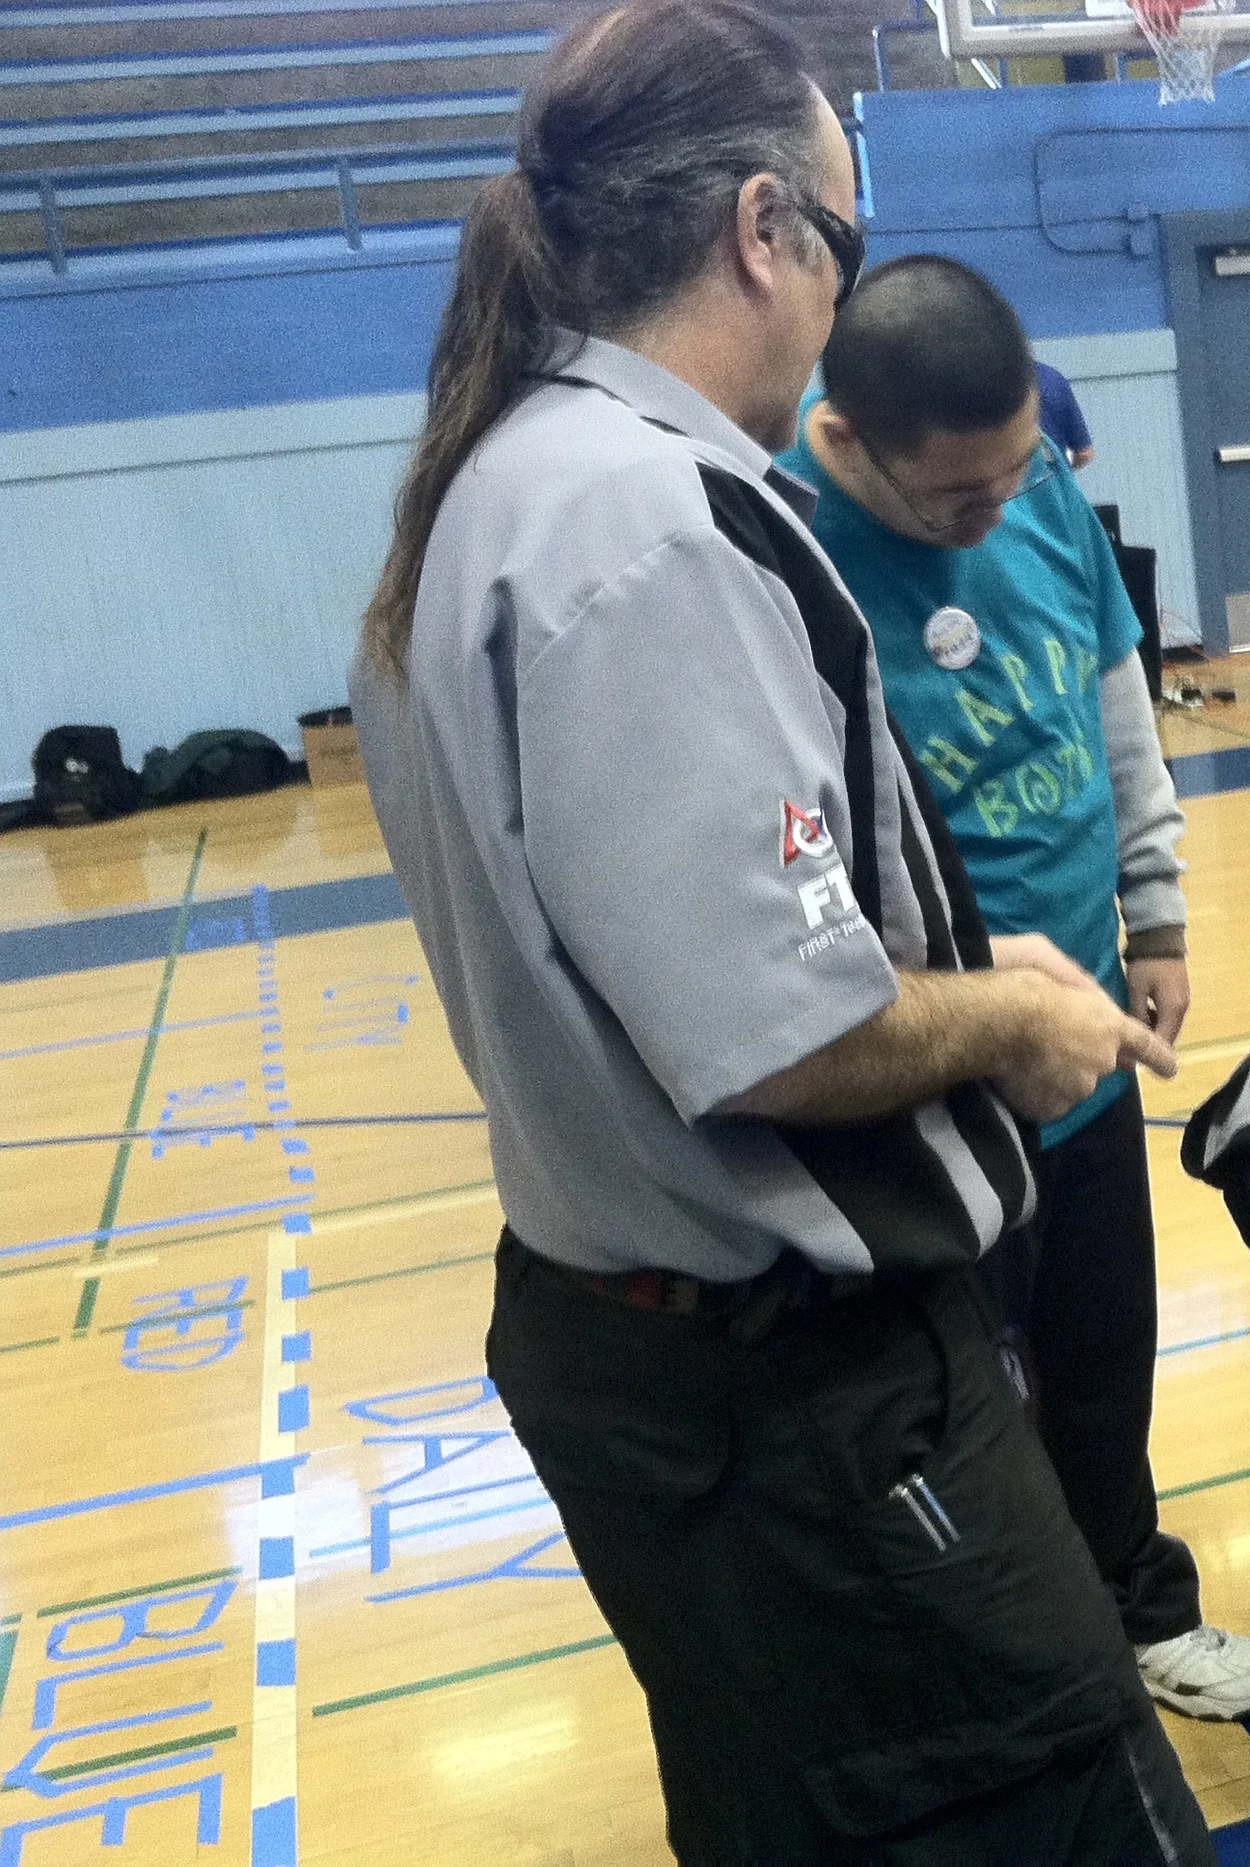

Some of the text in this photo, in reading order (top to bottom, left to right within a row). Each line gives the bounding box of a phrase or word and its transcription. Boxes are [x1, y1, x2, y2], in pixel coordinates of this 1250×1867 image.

[121, 1275, 249, 1371] RED
[342, 1375, 583, 1603] DALY
[0, 1581, 236, 1867] BLUE
